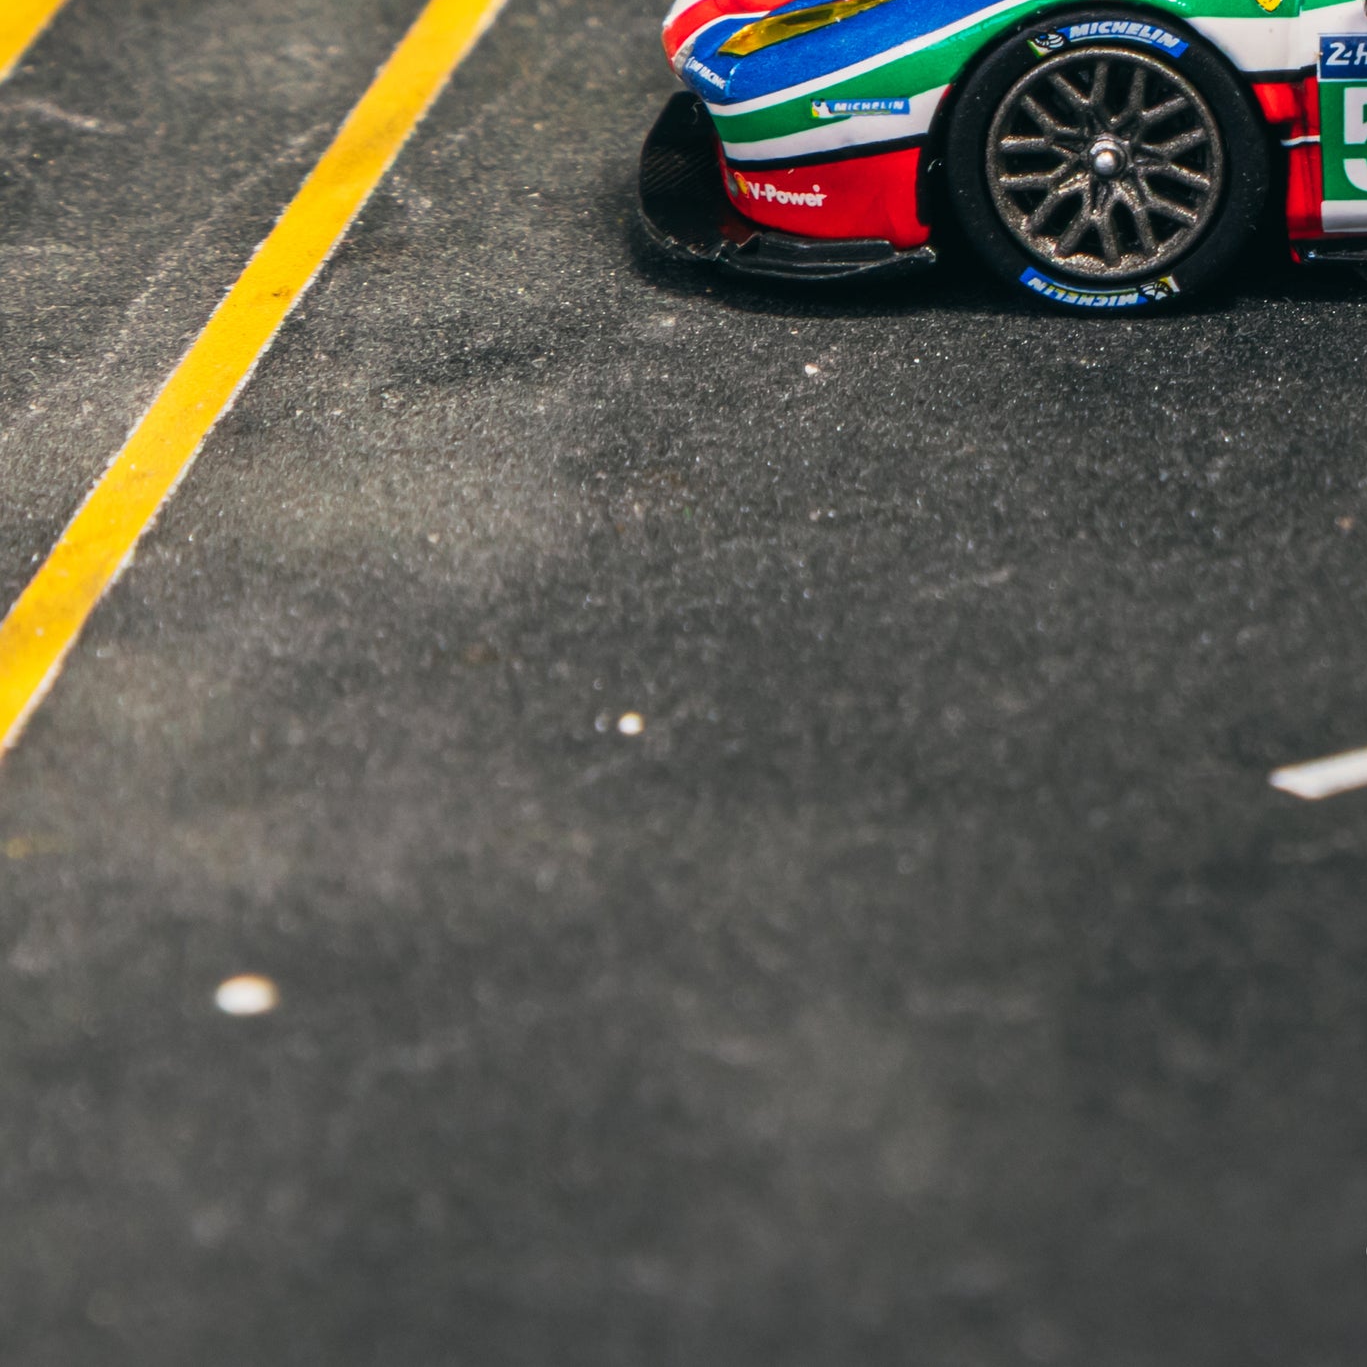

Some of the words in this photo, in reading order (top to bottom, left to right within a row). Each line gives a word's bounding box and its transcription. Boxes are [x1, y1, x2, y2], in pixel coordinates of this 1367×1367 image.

[1069, 20, 1181, 49] MICHELIN
[833, 99, 905, 112] MICHELIN
[747, 181, 828, 208] V-Power
[1027, 276, 1140, 307] MICHELIN
